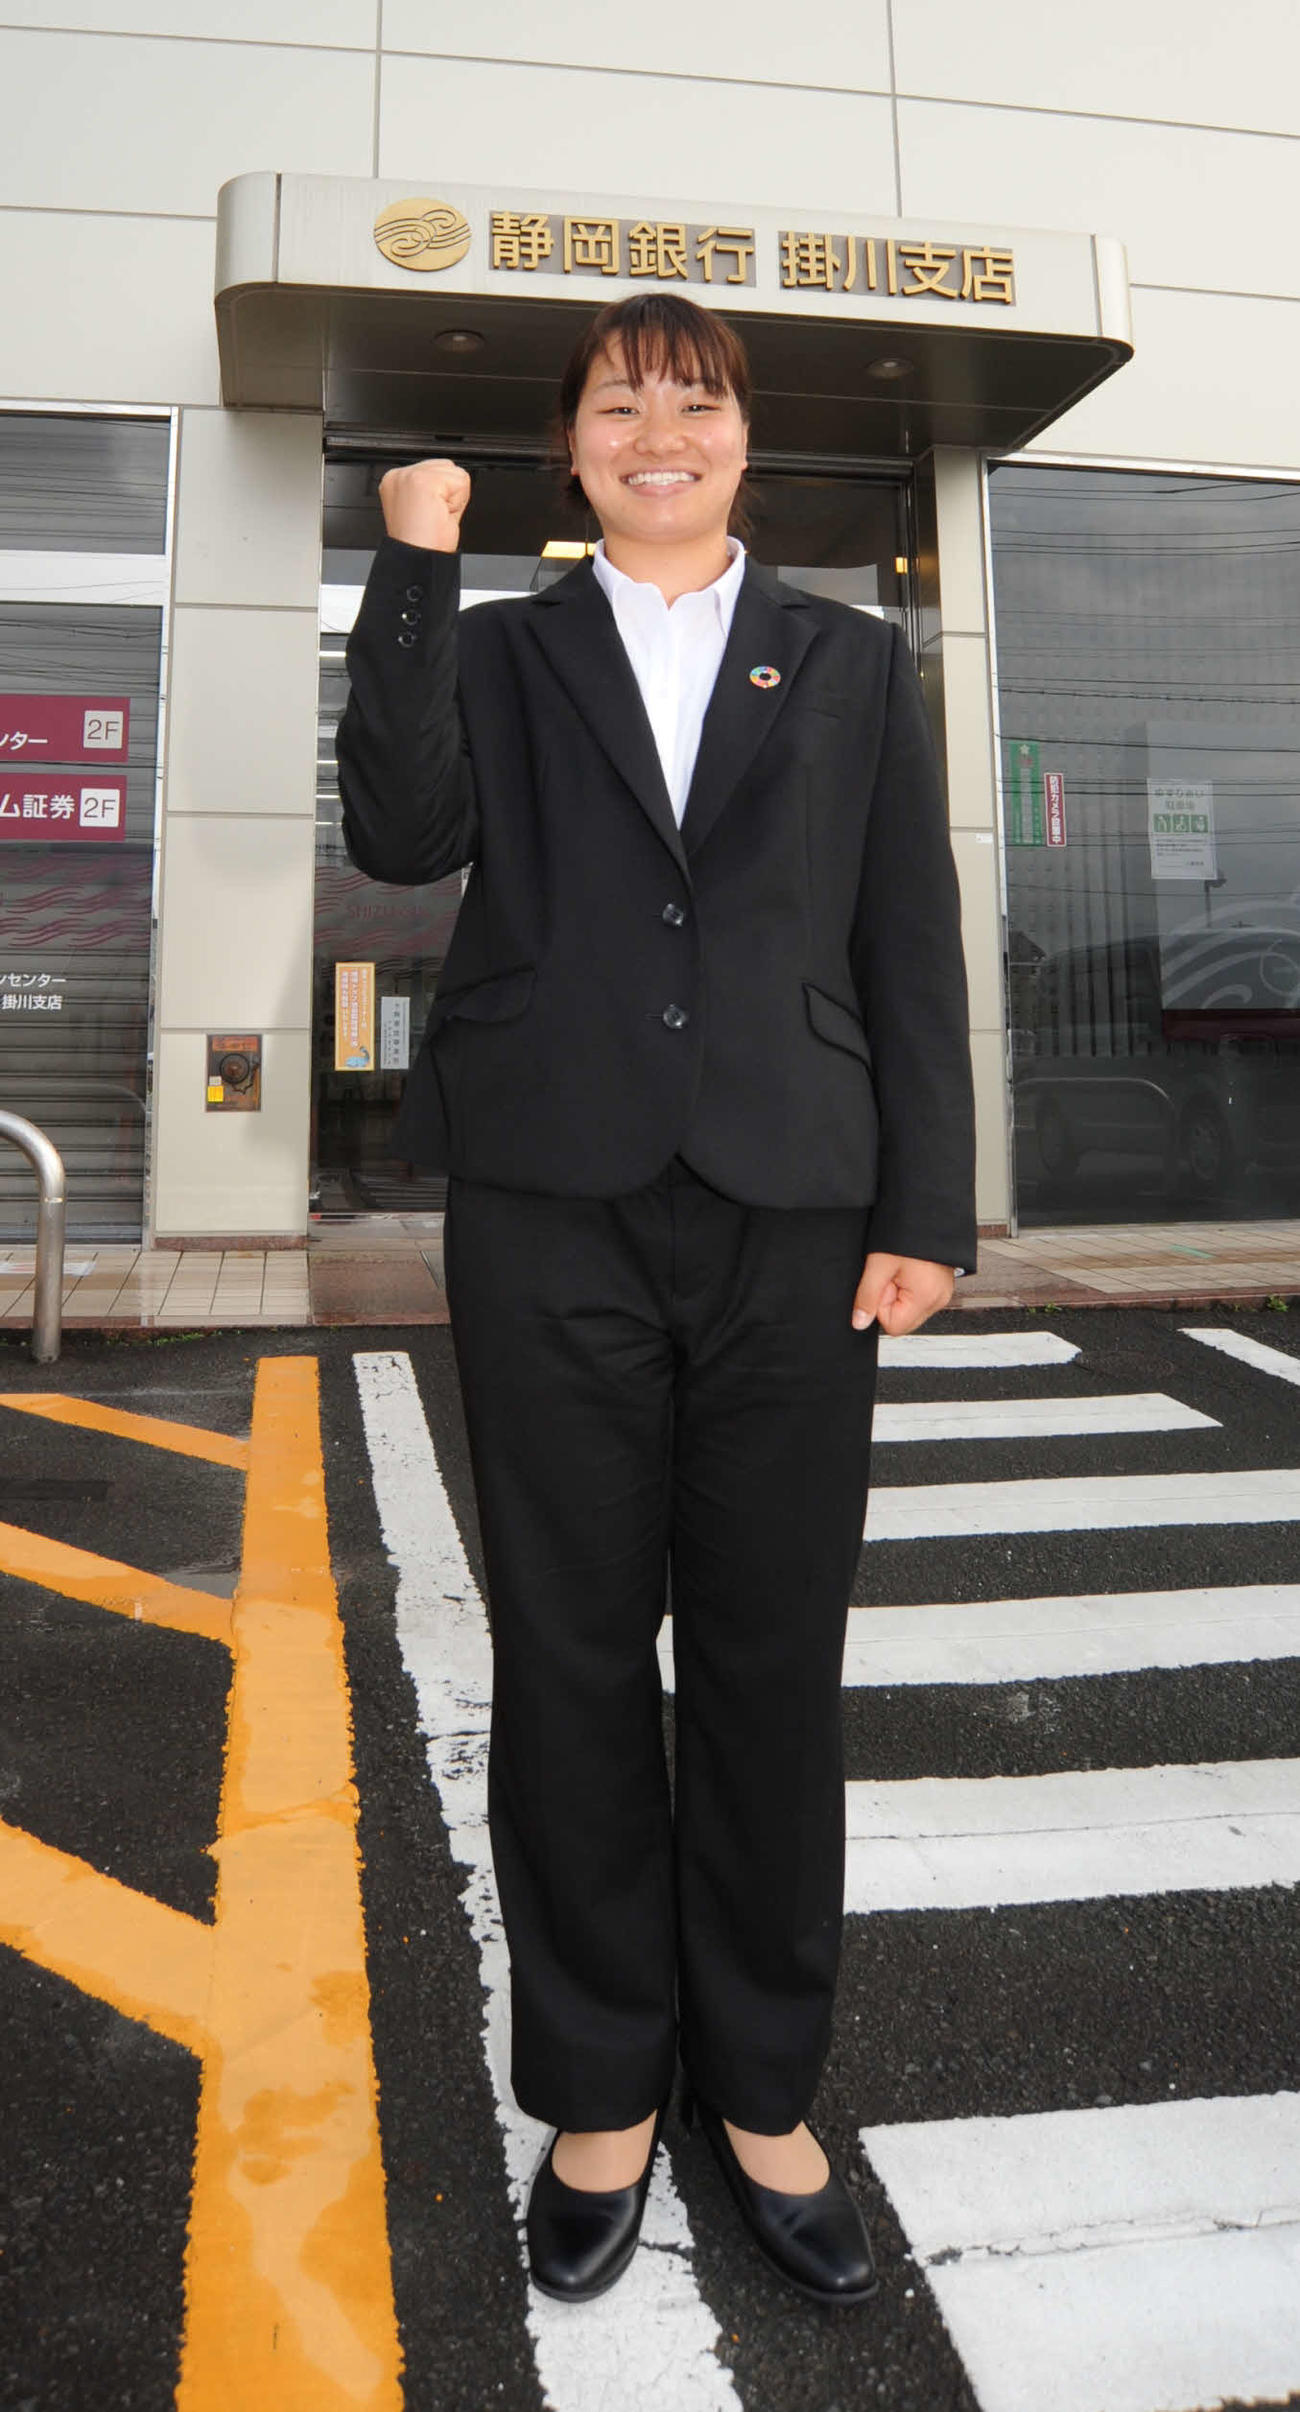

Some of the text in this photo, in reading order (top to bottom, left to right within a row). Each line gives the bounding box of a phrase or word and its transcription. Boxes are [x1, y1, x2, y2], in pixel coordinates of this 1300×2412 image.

[491, 210, 1015, 304] 静岡銀行 掛川支店
[87, 719, 119, 740] 2F
[0, 793, 116, 819] ム証券 2F
[2, 994, 63, 1010] 掛川支店
